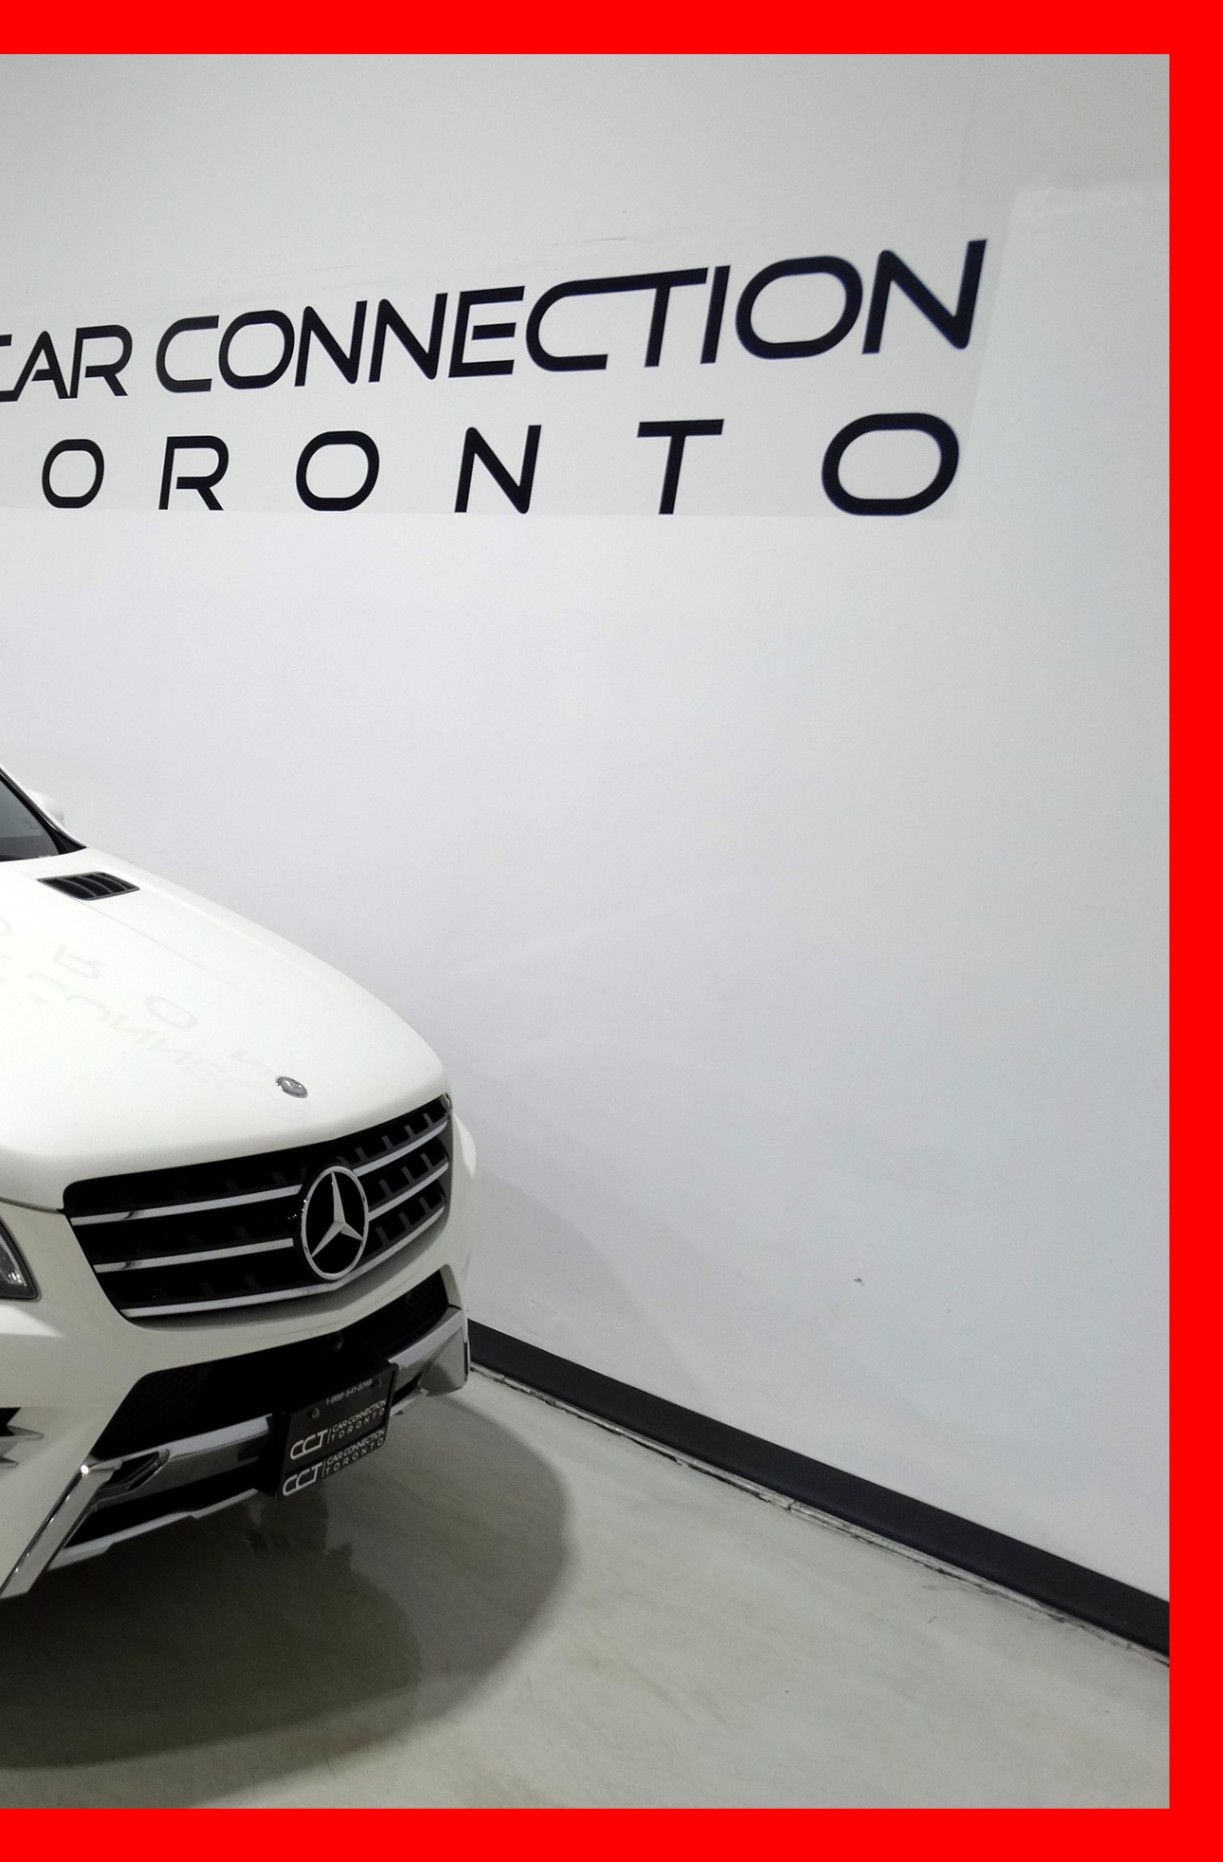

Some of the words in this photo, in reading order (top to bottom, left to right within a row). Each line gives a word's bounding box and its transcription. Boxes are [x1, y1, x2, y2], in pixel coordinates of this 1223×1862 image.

[155, 239, 988, 394] CONNECTION
[331, 1407, 385, 1442] TORONTO
[332, 1419, 347, 1433] CAR
[348, 1399, 387, 1425] CONNECTION
[290, 1428, 328, 1460] CCT
[325, 1437, 384, 1475] TORONTO
[327, 1451, 343, 1465] CAR
[343, 1427, 385, 1456] CONNECTION
[282, 1462, 323, 1496] CCT
